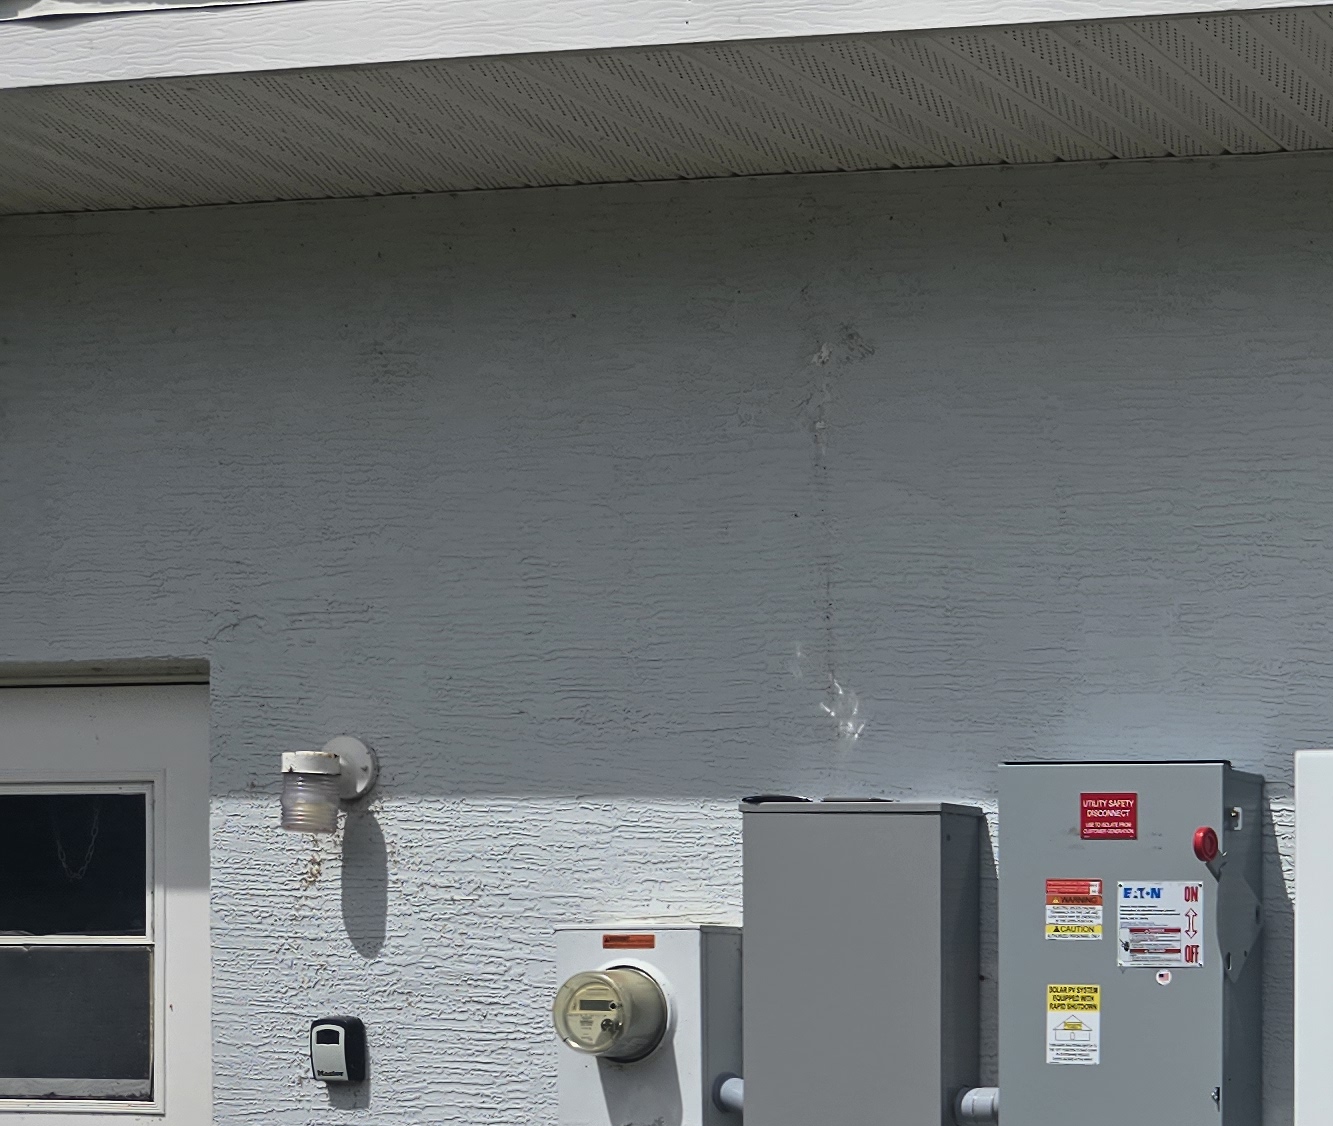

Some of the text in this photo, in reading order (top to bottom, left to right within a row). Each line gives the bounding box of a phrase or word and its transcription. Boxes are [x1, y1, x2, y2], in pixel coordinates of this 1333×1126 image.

[1082, 799, 1135, 808] UTILITY SAFETY
[1086, 809, 1131, 817] DISCONNECT
[1184, 886, 1199, 902] ON
[1060, 896, 1098, 904] WARNING
[1060, 925, 1095, 933] CAUTION
[1184, 944, 1200, 963] OFF
[1048, 986, 1098, 994] SOLAR PV SYSTEM
[1052, 994, 1080, 1002] EQUIPPED
[1049, 1002, 1067, 1010] RAPID
